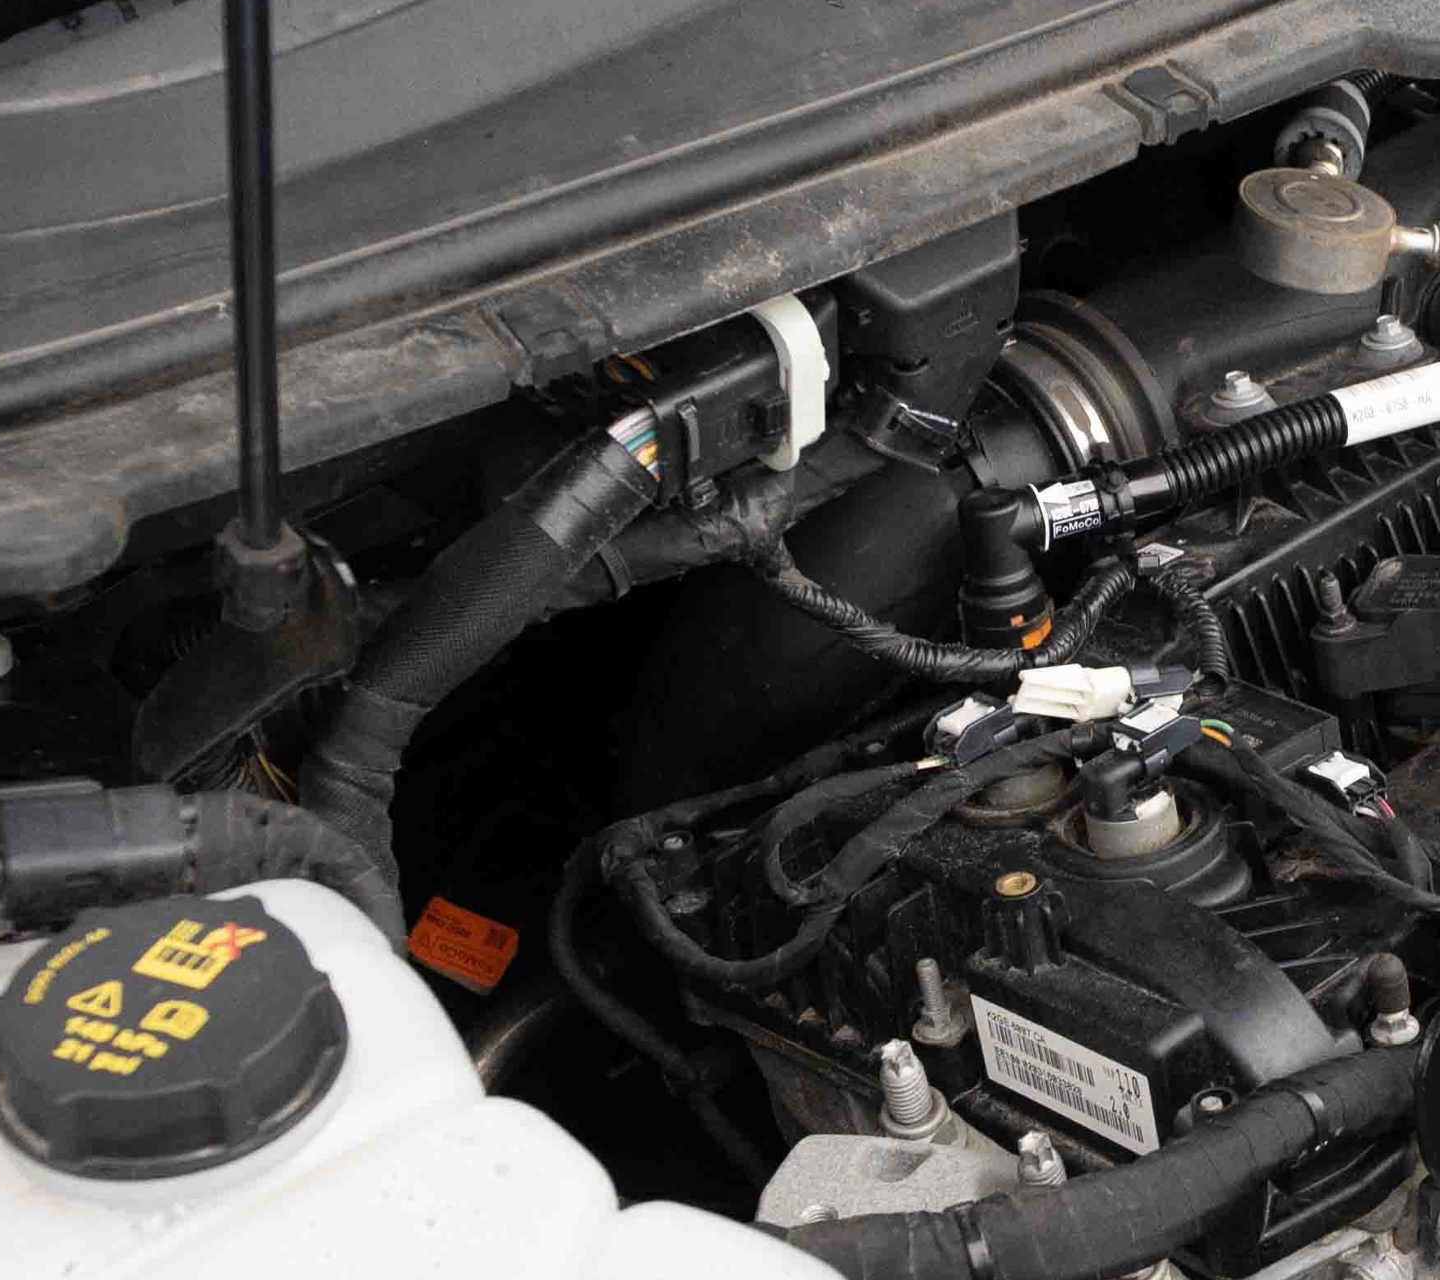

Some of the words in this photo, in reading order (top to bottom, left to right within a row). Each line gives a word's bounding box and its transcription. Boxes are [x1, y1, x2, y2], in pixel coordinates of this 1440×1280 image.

[1055, 516, 1101, 536] FoMoCo
[1114, 1068, 1142, 1098] 110
[1110, 1095, 1131, 1119] 2.0
